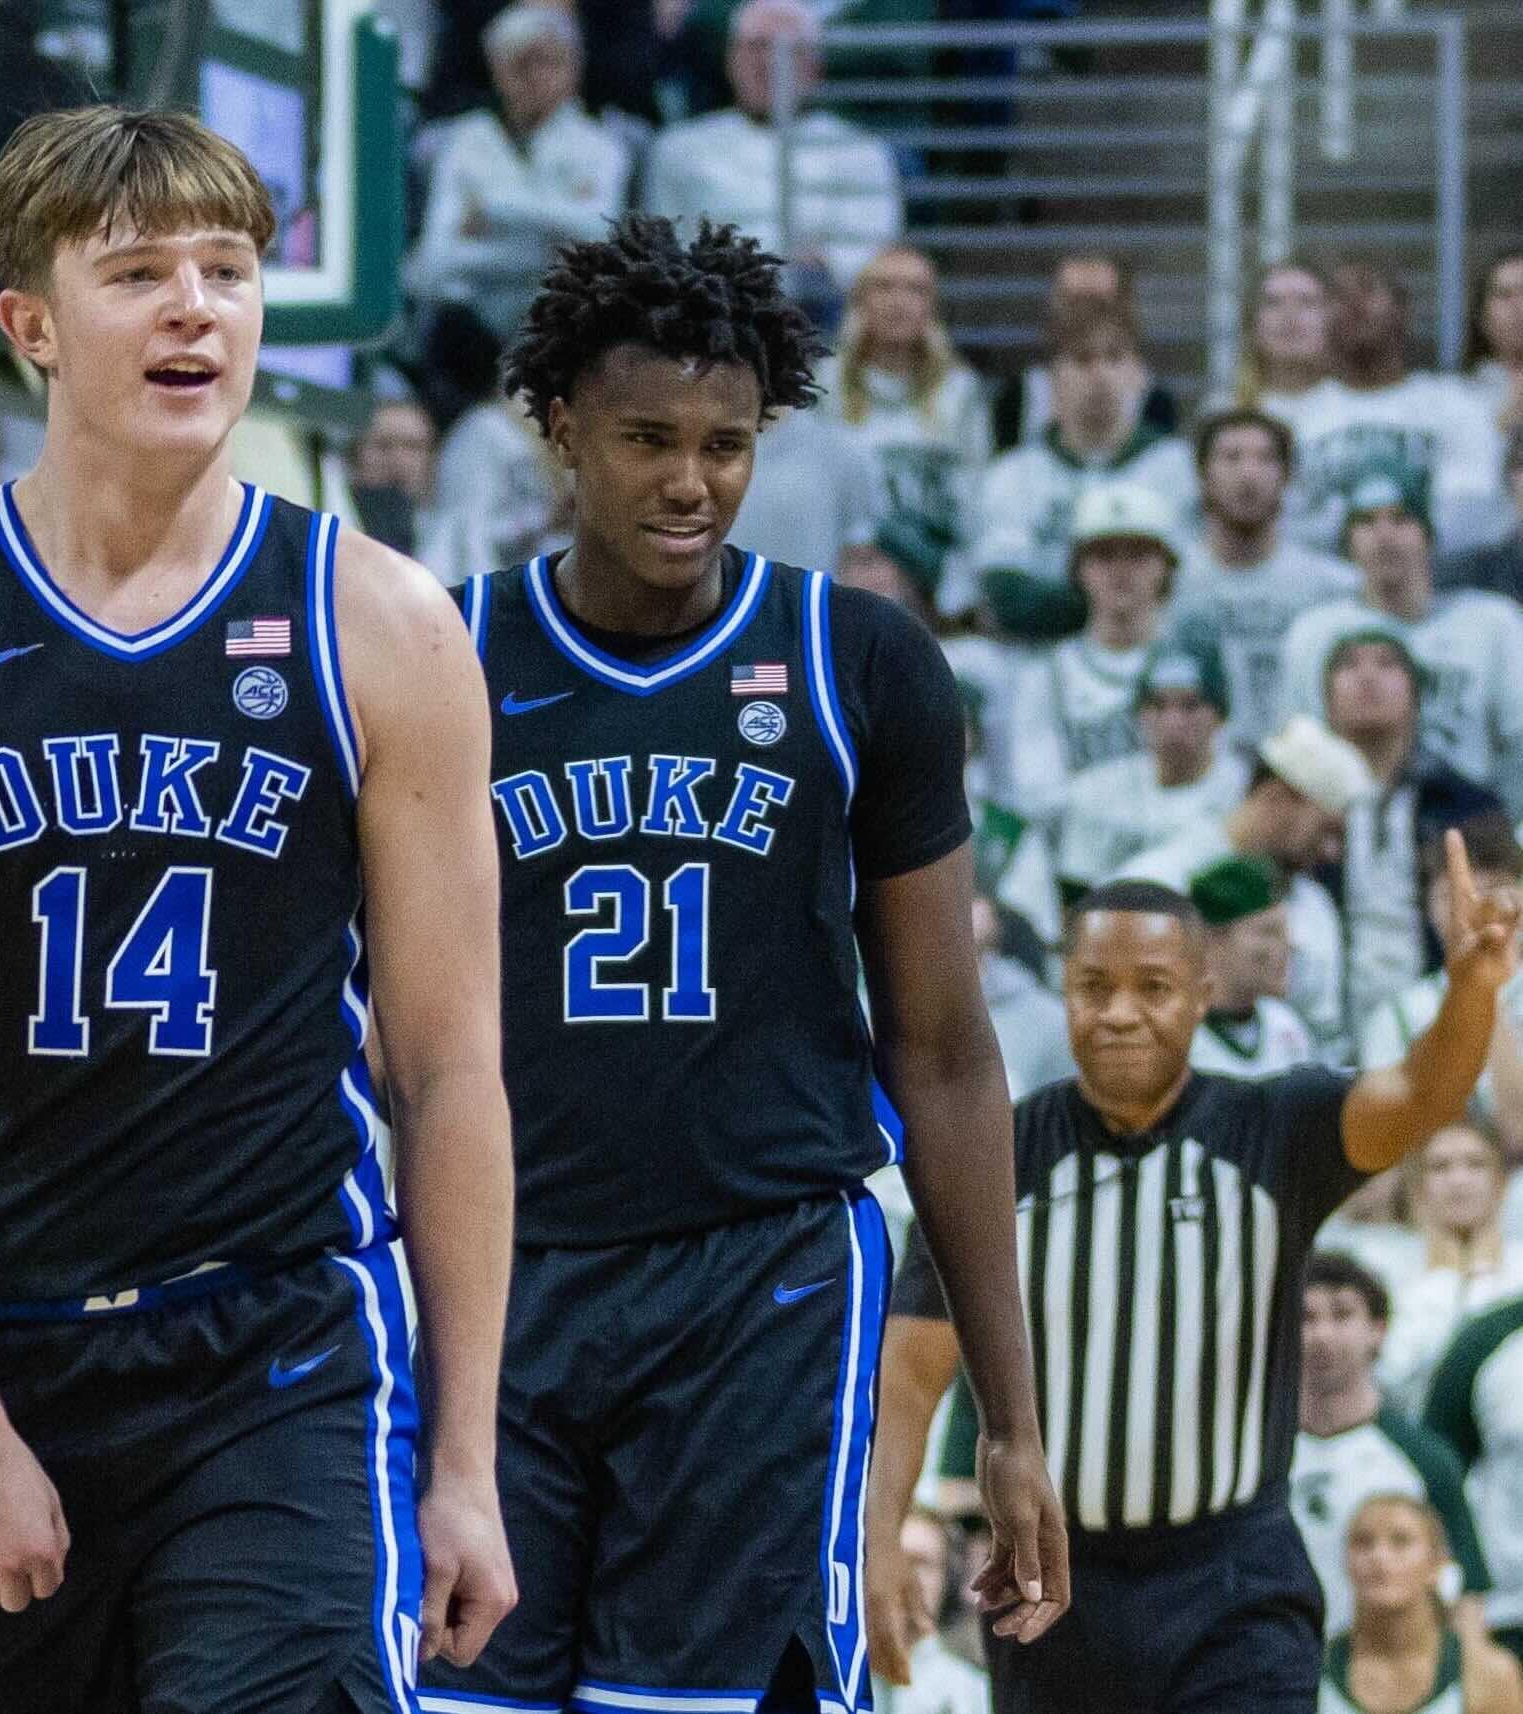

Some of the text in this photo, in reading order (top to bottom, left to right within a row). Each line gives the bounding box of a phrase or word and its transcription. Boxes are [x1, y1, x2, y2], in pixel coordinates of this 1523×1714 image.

[491, 754, 795, 860] DUKE
[27, 865, 218, 1057] 14
[563, 862, 716, 1023] 21
